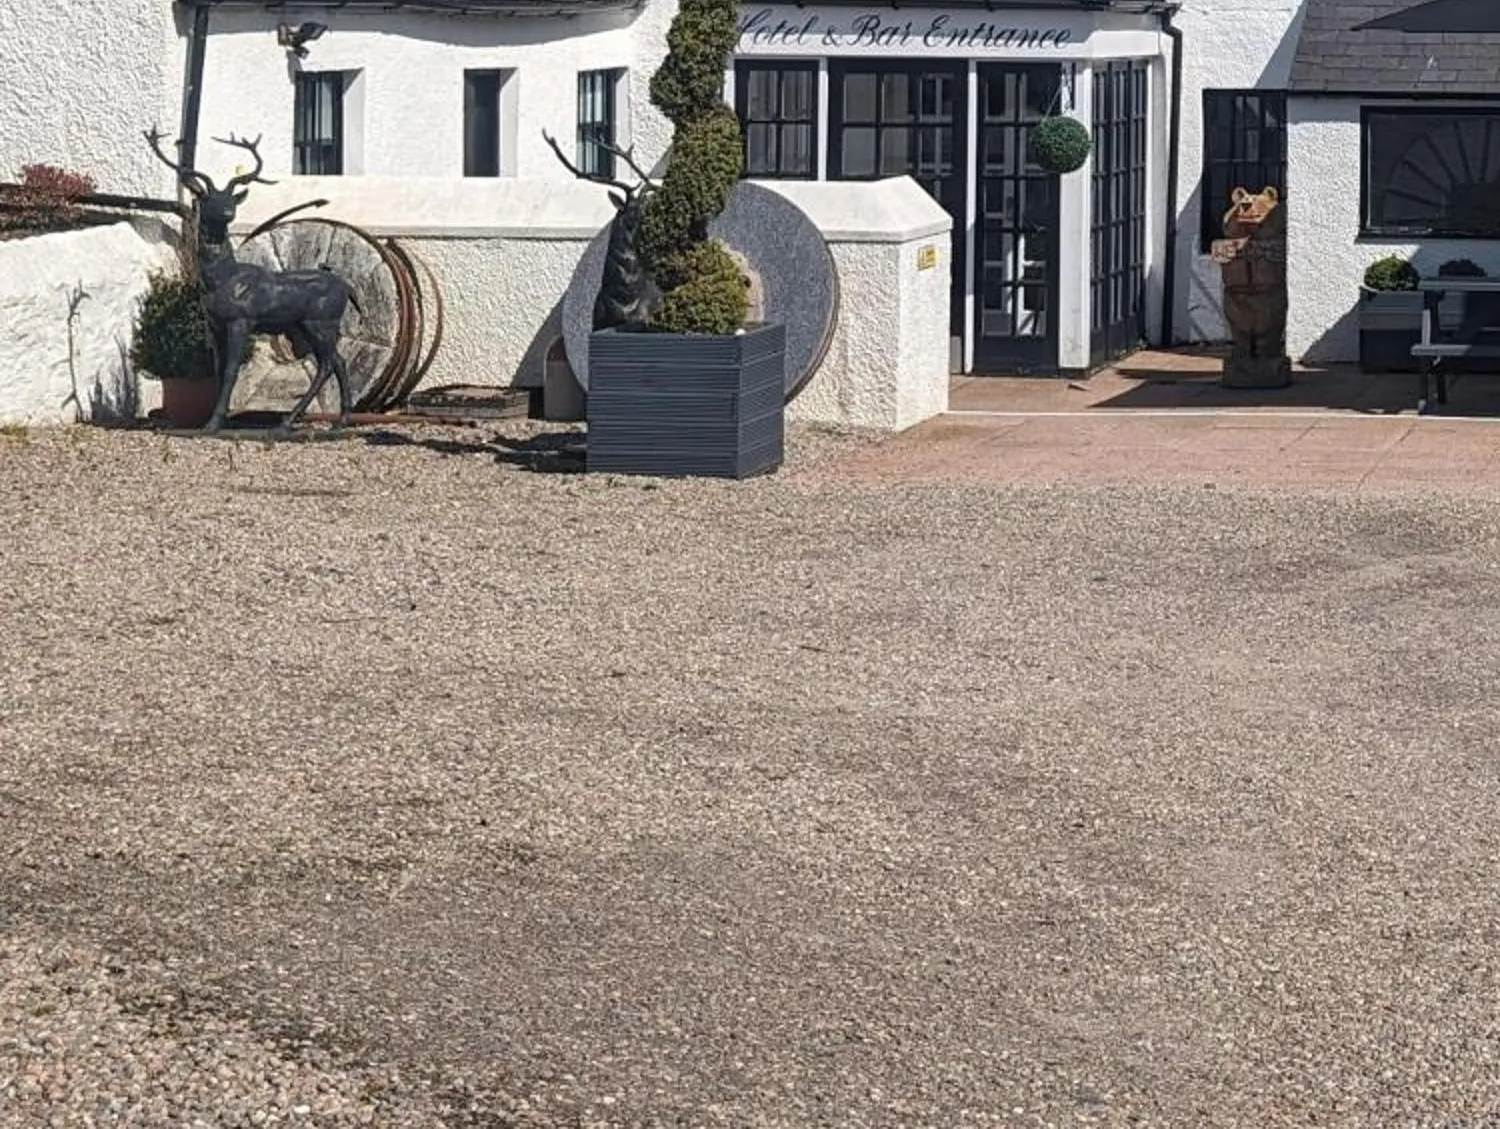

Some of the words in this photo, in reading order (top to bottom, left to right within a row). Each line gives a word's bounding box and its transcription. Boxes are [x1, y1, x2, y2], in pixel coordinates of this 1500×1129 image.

[821, 24, 841, 46] &
[847, 14, 912, 47] Bar
[923, 14, 1071, 49] Entrance
